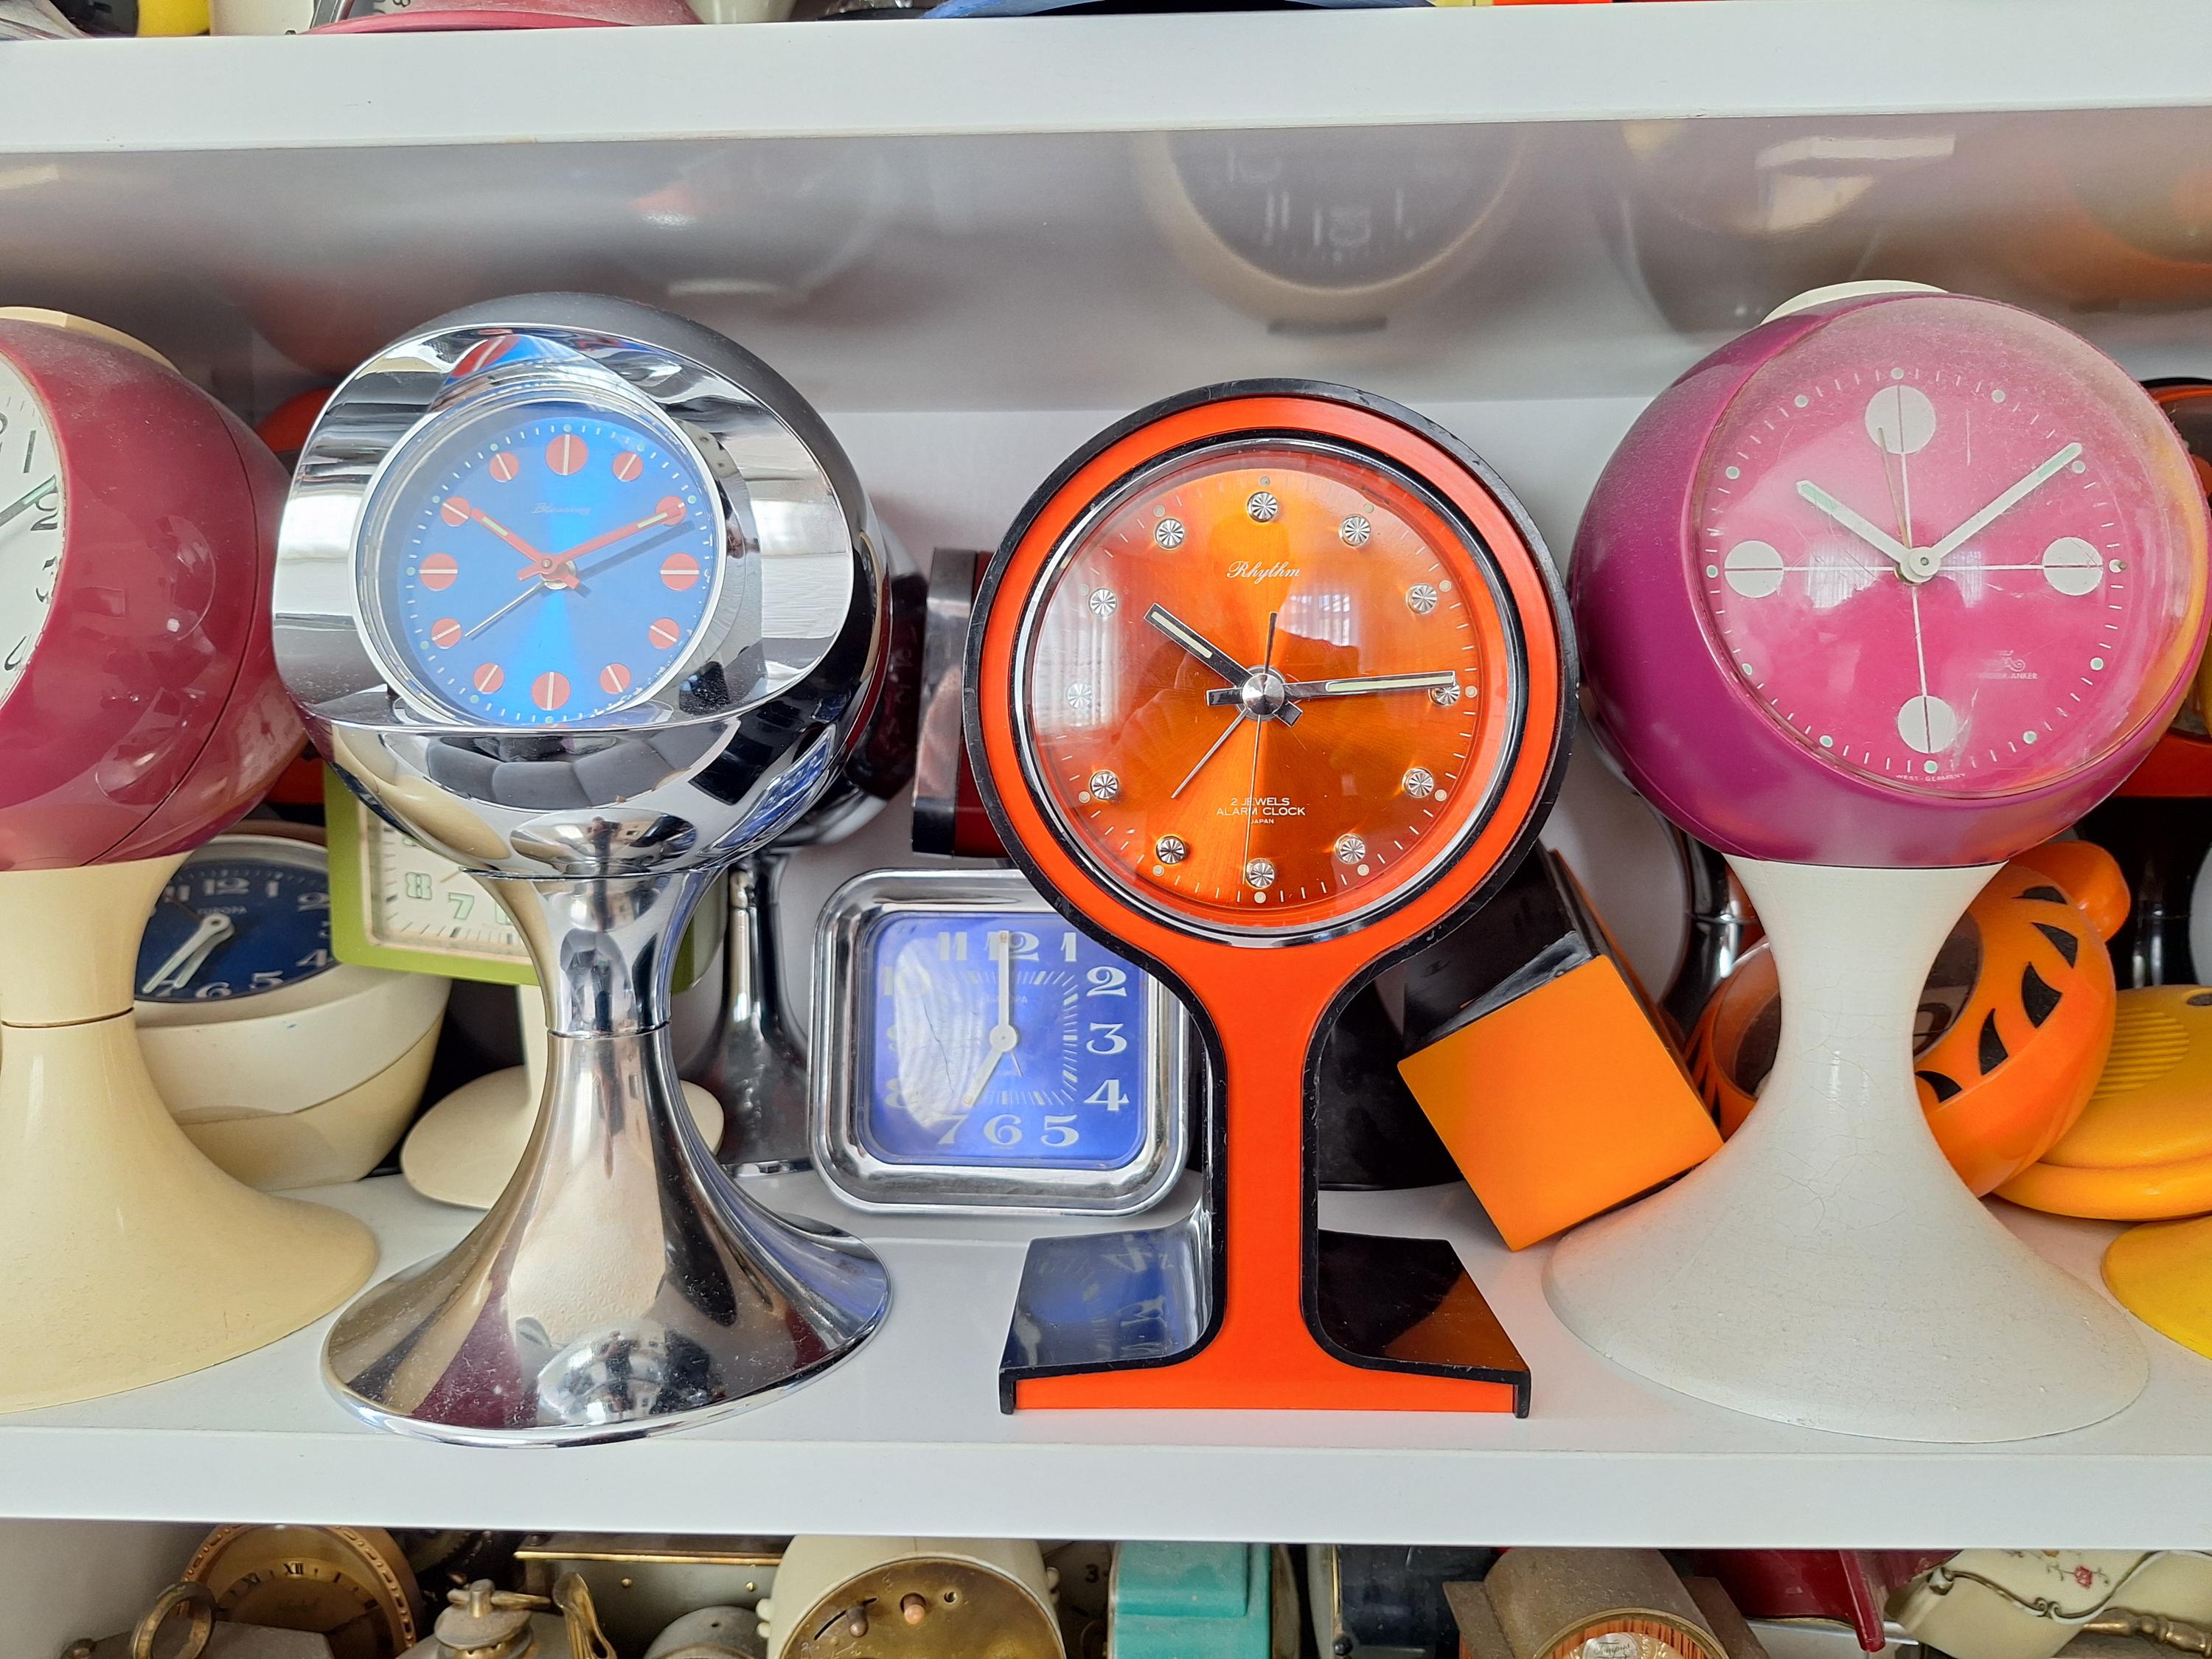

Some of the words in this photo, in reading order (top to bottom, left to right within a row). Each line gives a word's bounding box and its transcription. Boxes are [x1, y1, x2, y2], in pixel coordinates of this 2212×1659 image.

[1226, 560, 1301, 584] Rhythm
[1216, 807, 1258, 816] ALARM
[1262, 807, 1306, 815] CLOCK
[1230, 797, 1238, 806] 2
[1240, 797, 1290, 806] JEWELS
[204, 877, 250, 896] 12
[266, 880, 279, 898] 1
[406, 872, 433, 900] 8
[296, 891, 330, 912] 2
[448, 892, 475, 920] 7
[296, 949, 332, 968] 4
[938, 931, 967, 961] 11
[984, 931, 1040, 961] 12
[1061, 932, 1077, 961] 1
[248, 970, 284, 991] 5
[1086, 966, 1127, 996] 2
[1086, 1023, 1127, 1054] 3
[1083, 1079, 1130, 1111] 4
[984, 1114, 1023, 1145] 6
[1040, 1114, 1079, 1147] 5
[282, 1562, 305, 1576] XII
[1085, 1564, 1099, 1584] 3
